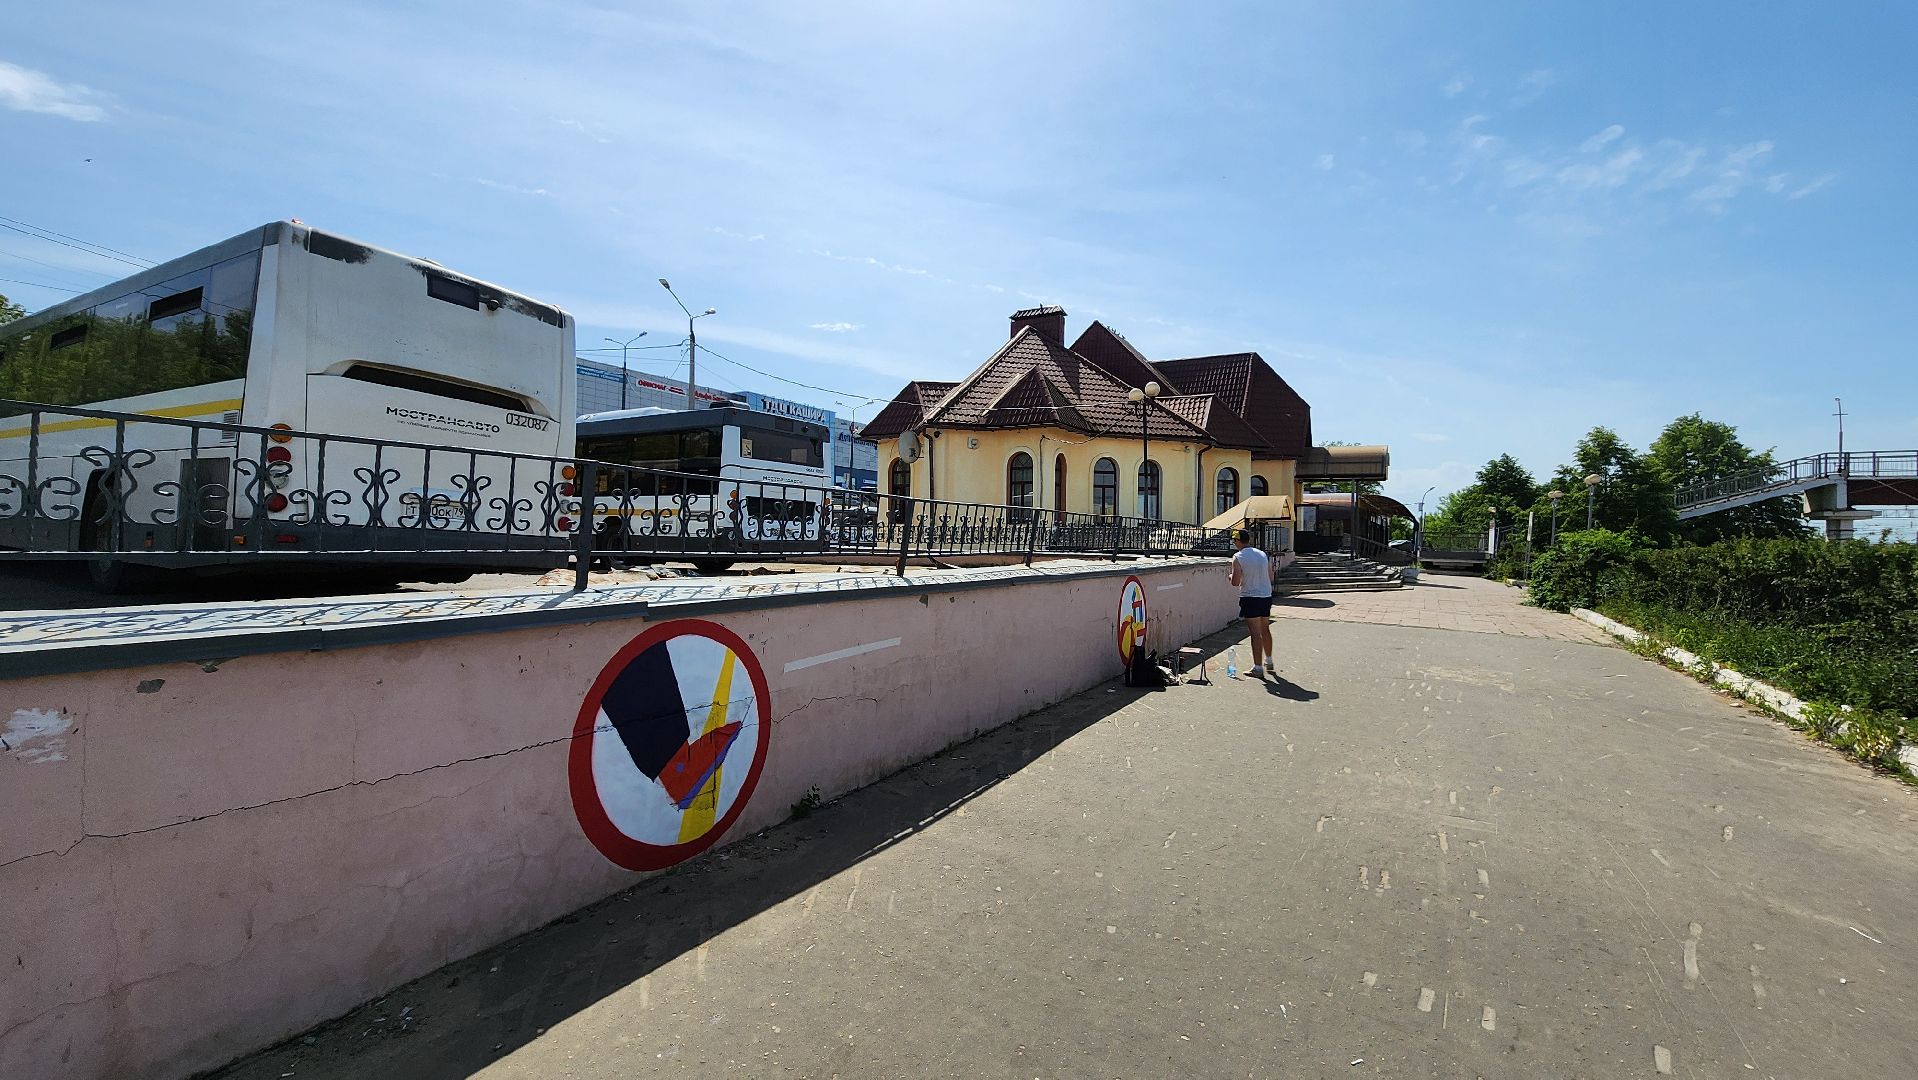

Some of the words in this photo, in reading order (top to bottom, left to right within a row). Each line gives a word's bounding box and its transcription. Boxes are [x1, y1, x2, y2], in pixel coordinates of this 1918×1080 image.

[386, 406, 501, 433] МОСТРАНСАВТО
[505, 412, 549, 432] 032087
[789, 402, 826, 422] КАШИРА
